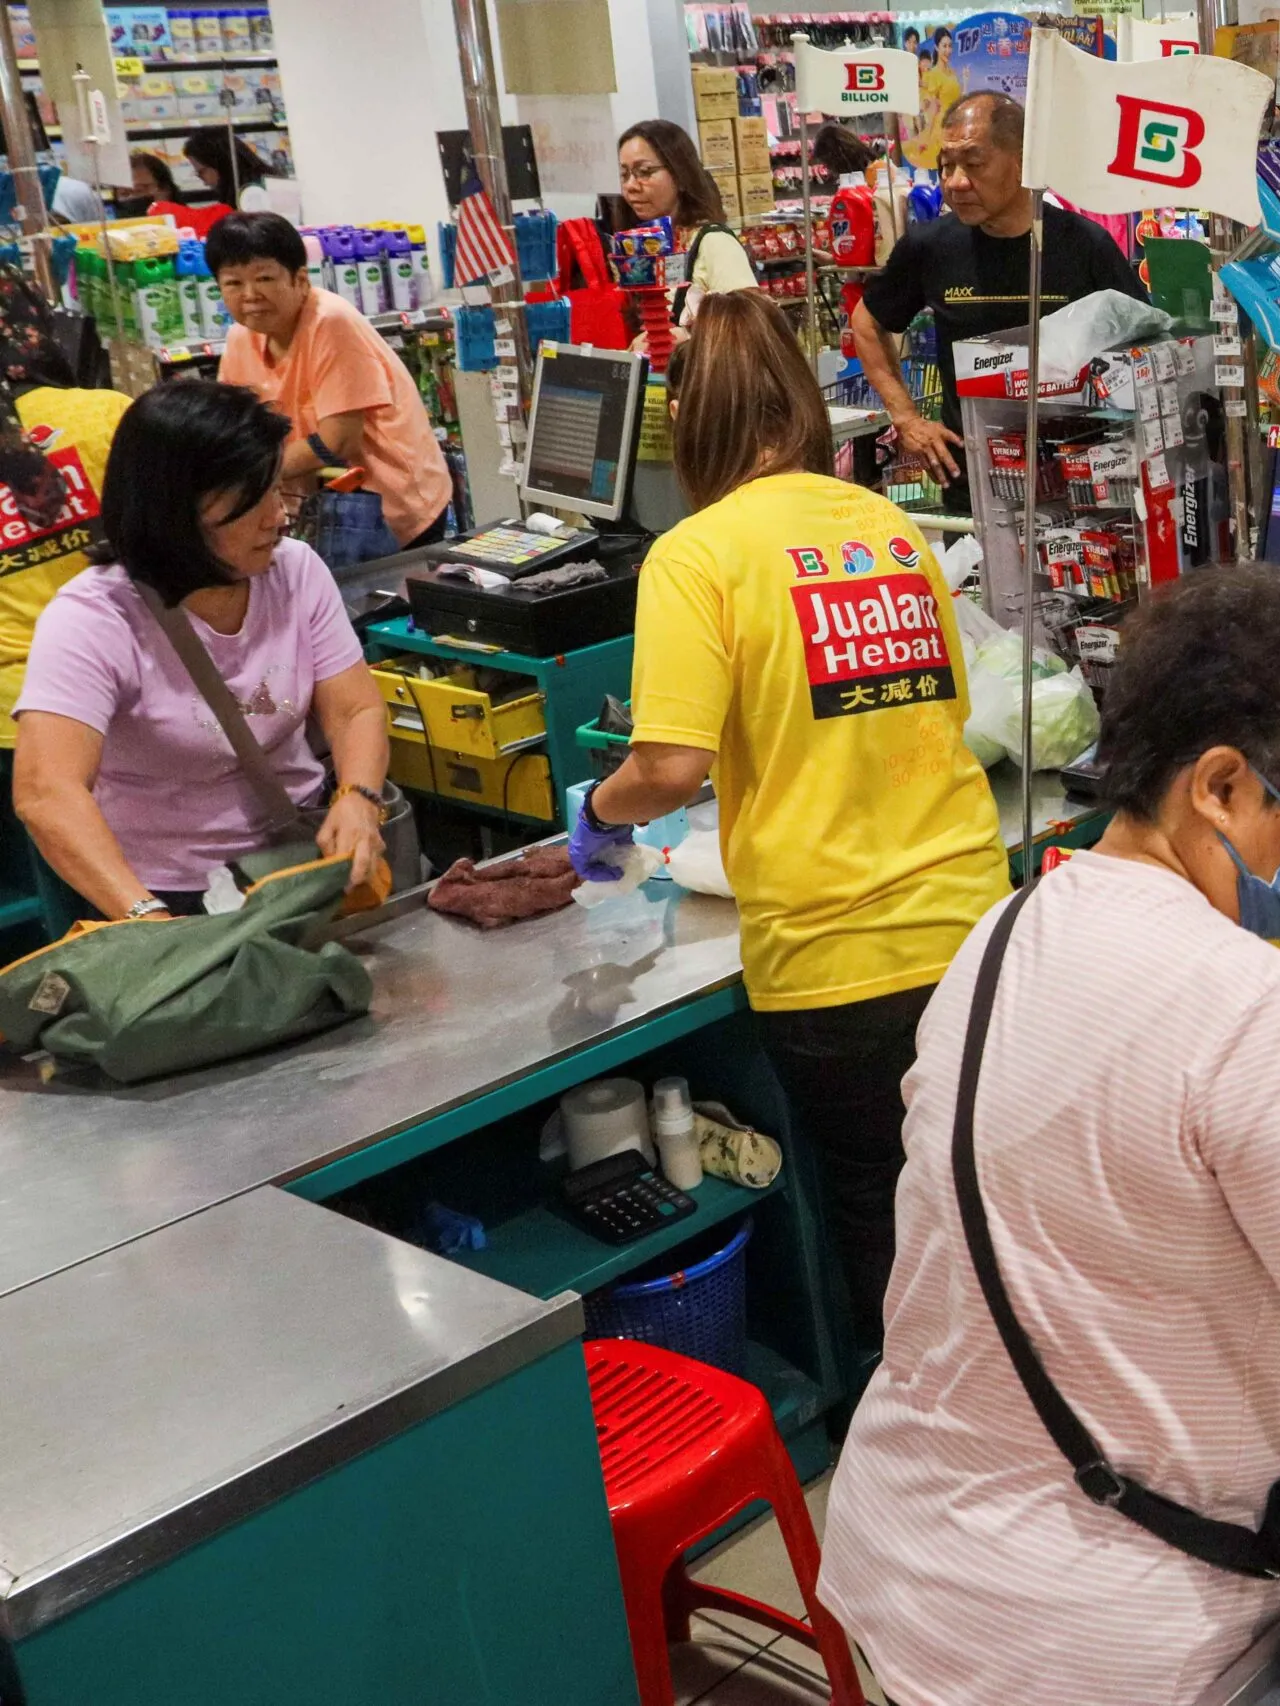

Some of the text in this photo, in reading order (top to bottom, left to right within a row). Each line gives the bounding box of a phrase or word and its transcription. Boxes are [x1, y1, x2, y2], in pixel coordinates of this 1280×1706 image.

[841, 92, 889, 103] BILLION
[944, 287, 974, 299] MAXX
[973, 352, 1014, 371] Energizer
[1046, 379, 1080, 393] BATTERY
[992, 446, 1021, 458] EVEREADY
[1183, 463, 1199, 548] Energizer
[810, 584, 939, 645] Jualan
[1080, 640, 1108, 650] Energizer
[823, 633, 942, 675] Hebat
[839, 673, 939, 711] 大减价
